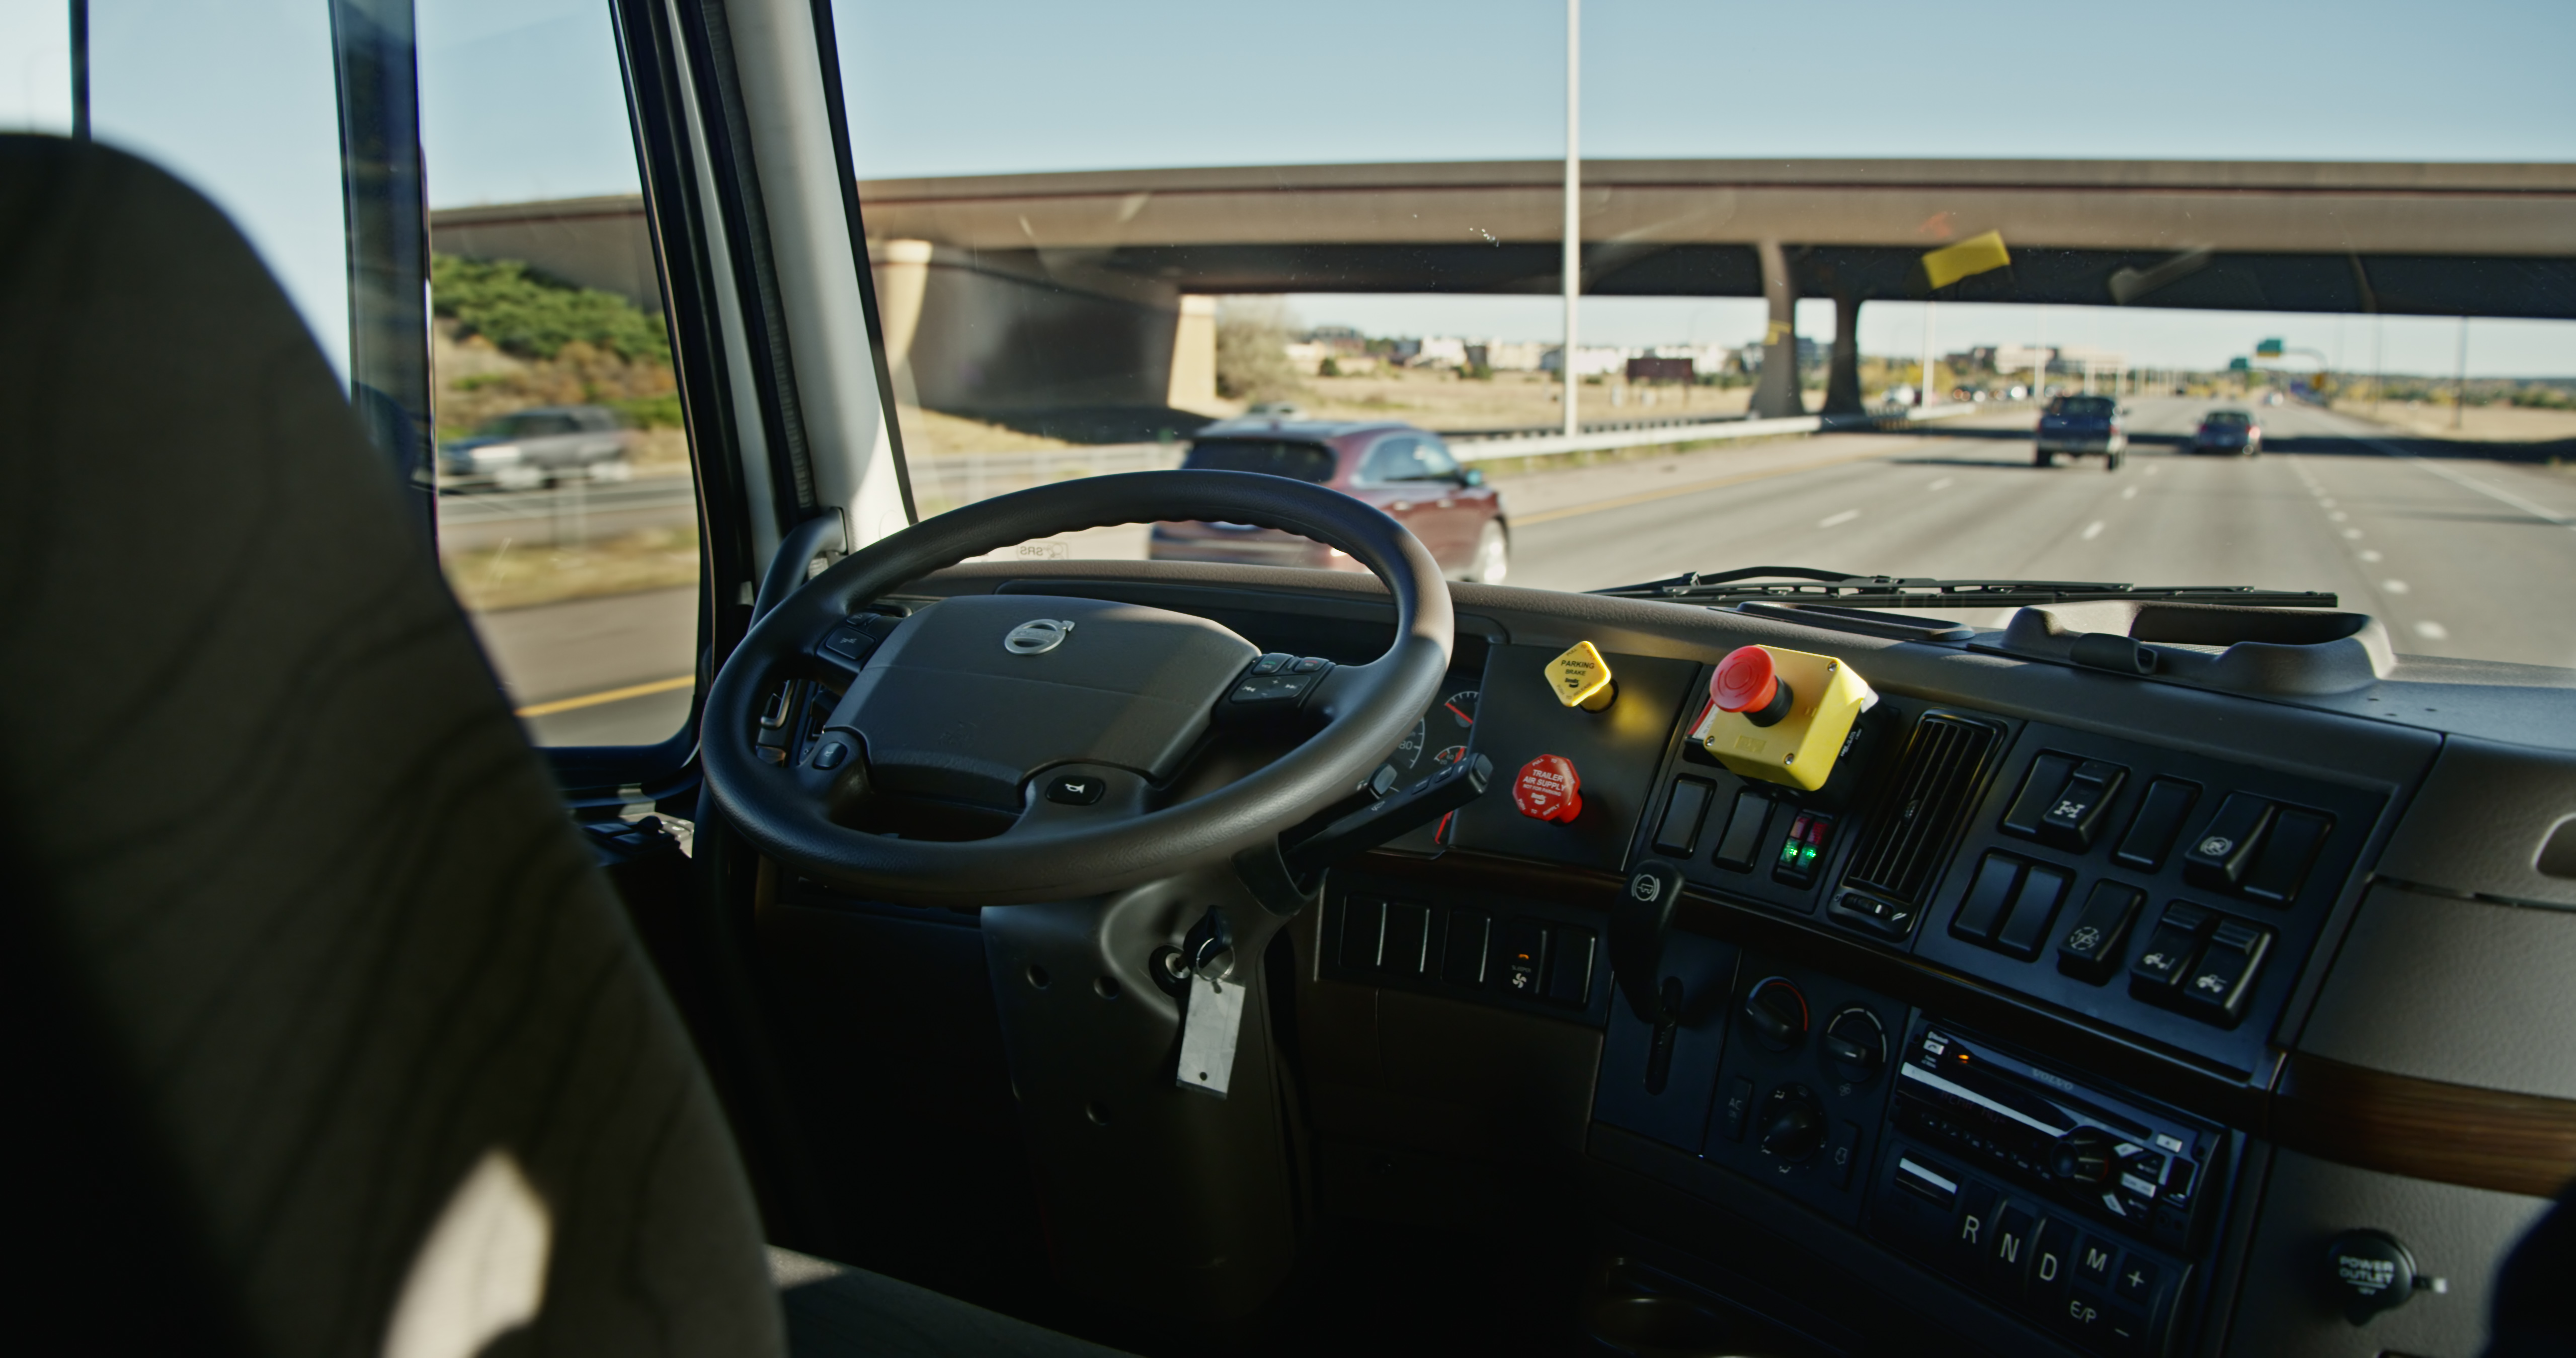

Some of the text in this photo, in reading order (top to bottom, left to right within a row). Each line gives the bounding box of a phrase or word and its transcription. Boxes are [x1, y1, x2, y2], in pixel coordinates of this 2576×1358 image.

[1561, 660, 1595, 669] PARKING
[1398, 740, 1413, 750] 80
[1522, 776, 1566, 791] AIR SUPPLY
[1533, 769, 1563, 782] TRAILER
[1542, 788, 1562, 796] PARKING
[2032, 1068, 2073, 1090] VOLVO
[1728, 1097, 1742, 1111] AC
[1962, 1214, 1980, 1244] R
[1999, 1232, 2021, 1263] N
[2039, 1252, 2058, 1282] D
[2086, 1248, 2108, 1272] M
[2340, 1255, 2394, 1272] POWER
[2339, 1267, 2394, 1285] OUTLET
[2069, 1300, 2097, 1324] E/P
